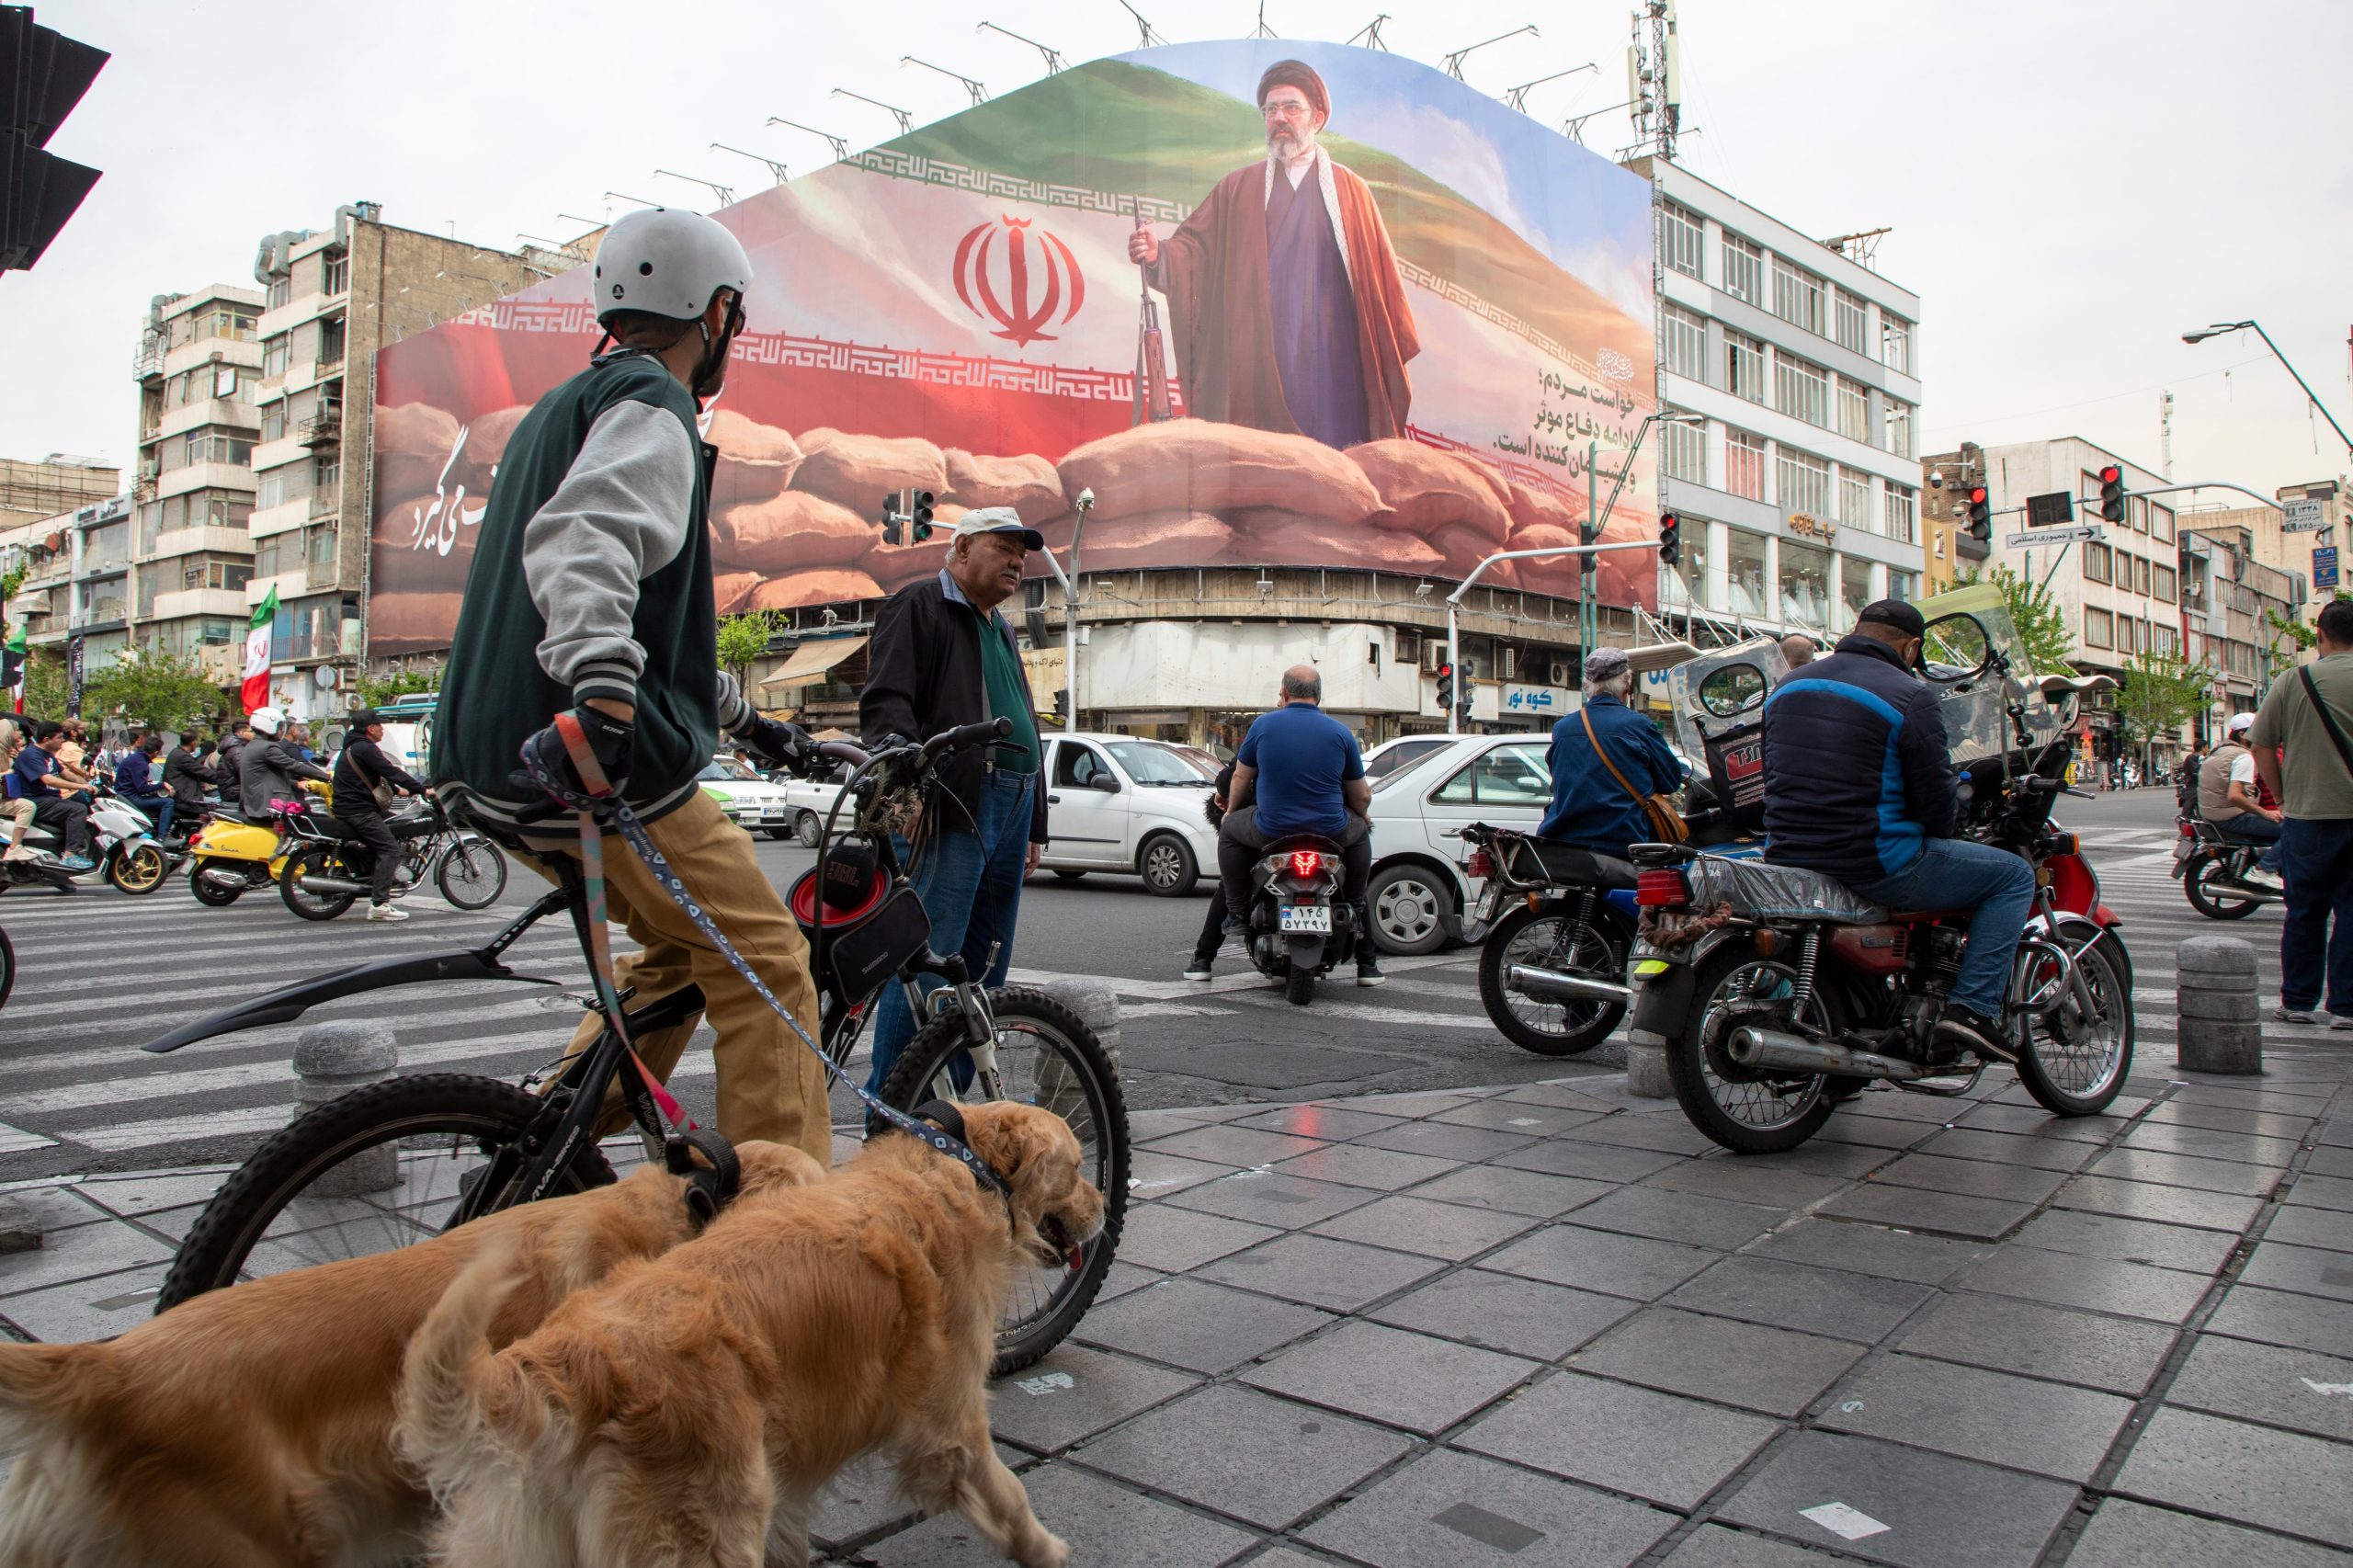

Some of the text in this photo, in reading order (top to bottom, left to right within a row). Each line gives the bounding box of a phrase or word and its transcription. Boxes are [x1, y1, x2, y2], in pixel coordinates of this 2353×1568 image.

[1591, 389, 1635, 419] خواست
[1533, 401, 1633, 449] ادامه دفاع موثر
[1493, 434, 1532, 455] است.
[1535, 443, 1568, 466] کننده
[1629, 472, 1636, 494] و
[2011, 534, 2067, 545] جمهوری اسلامی
[1049, 657, 1063, 667] دنیای
[1507, 688, 1552, 710] کوه نور
[825, 860, 860, 888] JBL
[1299, 906, 1324, 918] ۱۴۵
[1284, 919, 1328, 930] ۵۷۳۹۷
